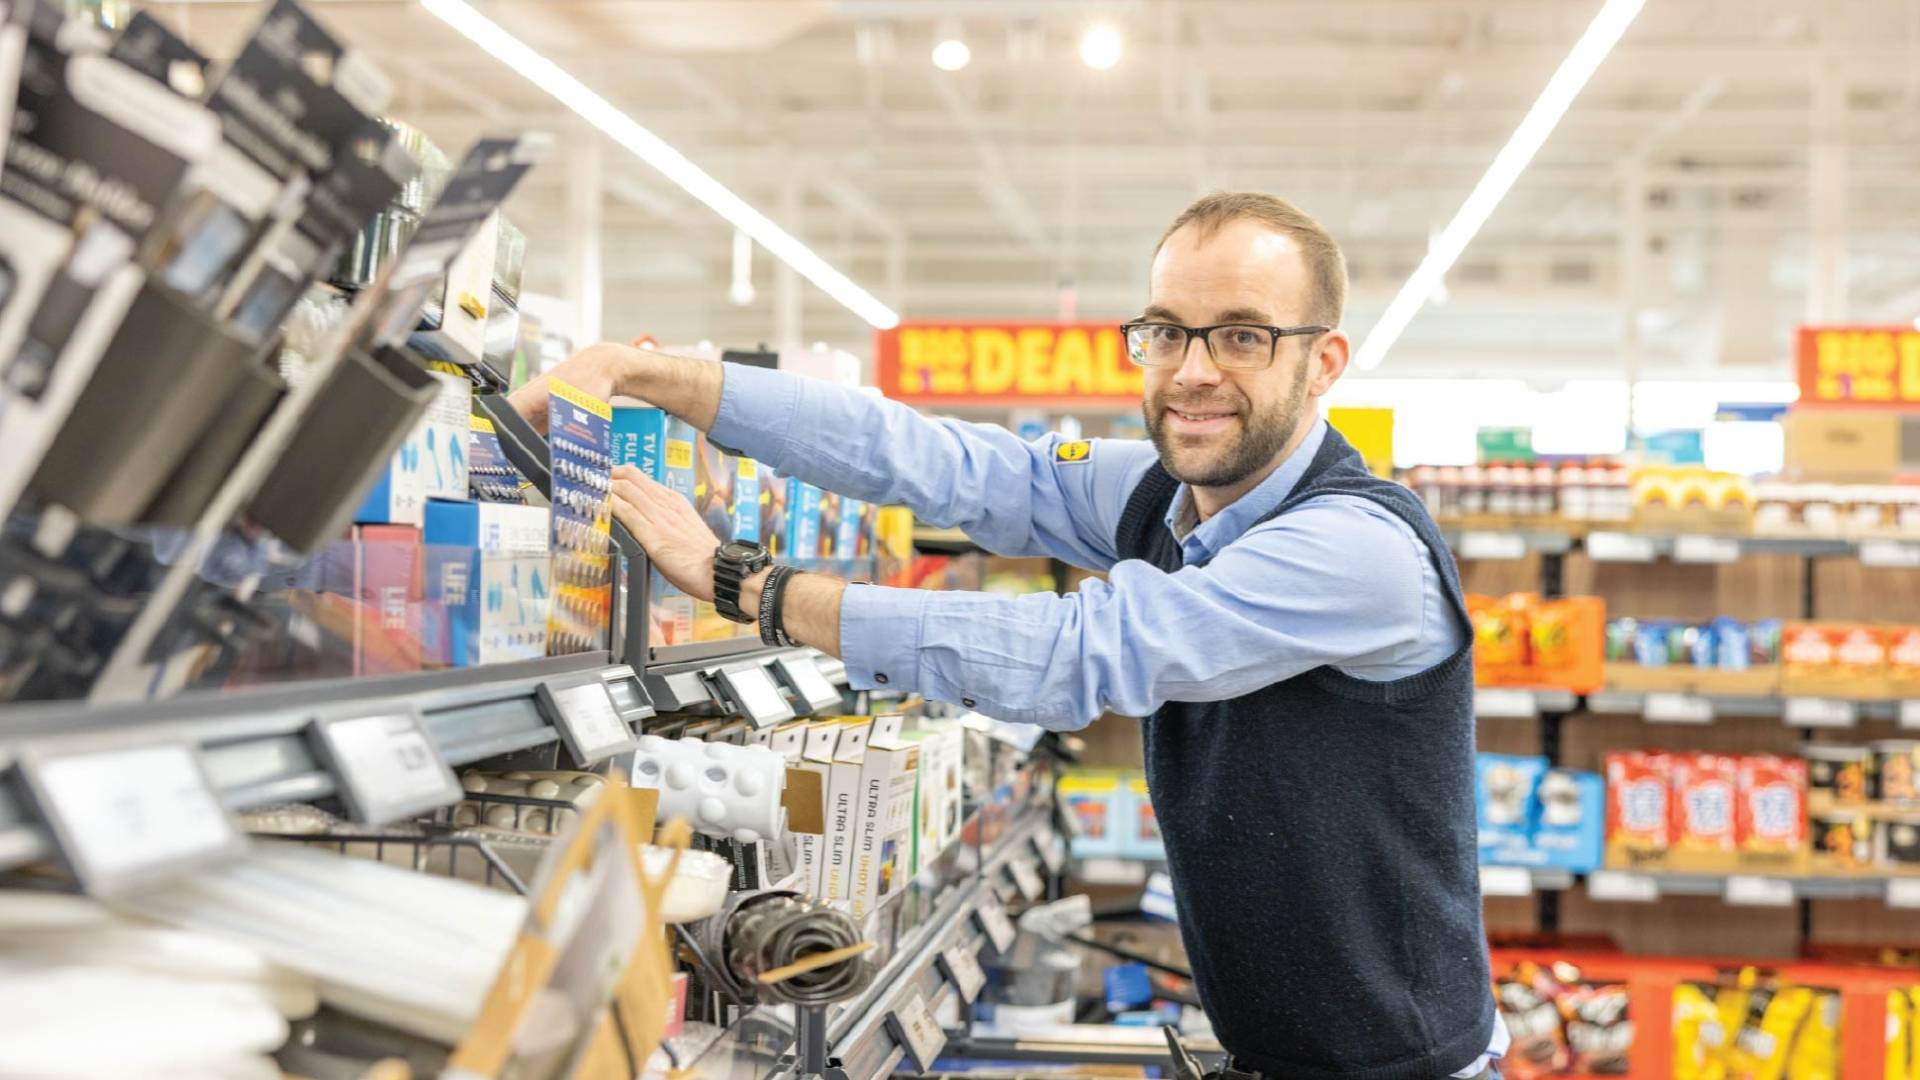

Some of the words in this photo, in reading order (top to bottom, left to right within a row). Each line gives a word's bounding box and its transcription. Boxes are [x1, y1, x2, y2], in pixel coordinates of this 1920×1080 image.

[972, 329, 1143, 395] DEAL
[644, 433, 655, 453] TV
[442, 562, 466, 605] LIFE
[381, 587, 407, 629] LIFE
[835, 793, 848, 832] ULTRA
[867, 779, 880, 818] ULTRA
[802, 835, 814, 865] SLIM
[832, 836, 845, 865] SLIM
[863, 821, 876, 851] SLIM
[856, 855, 870, 896] UHDTV
